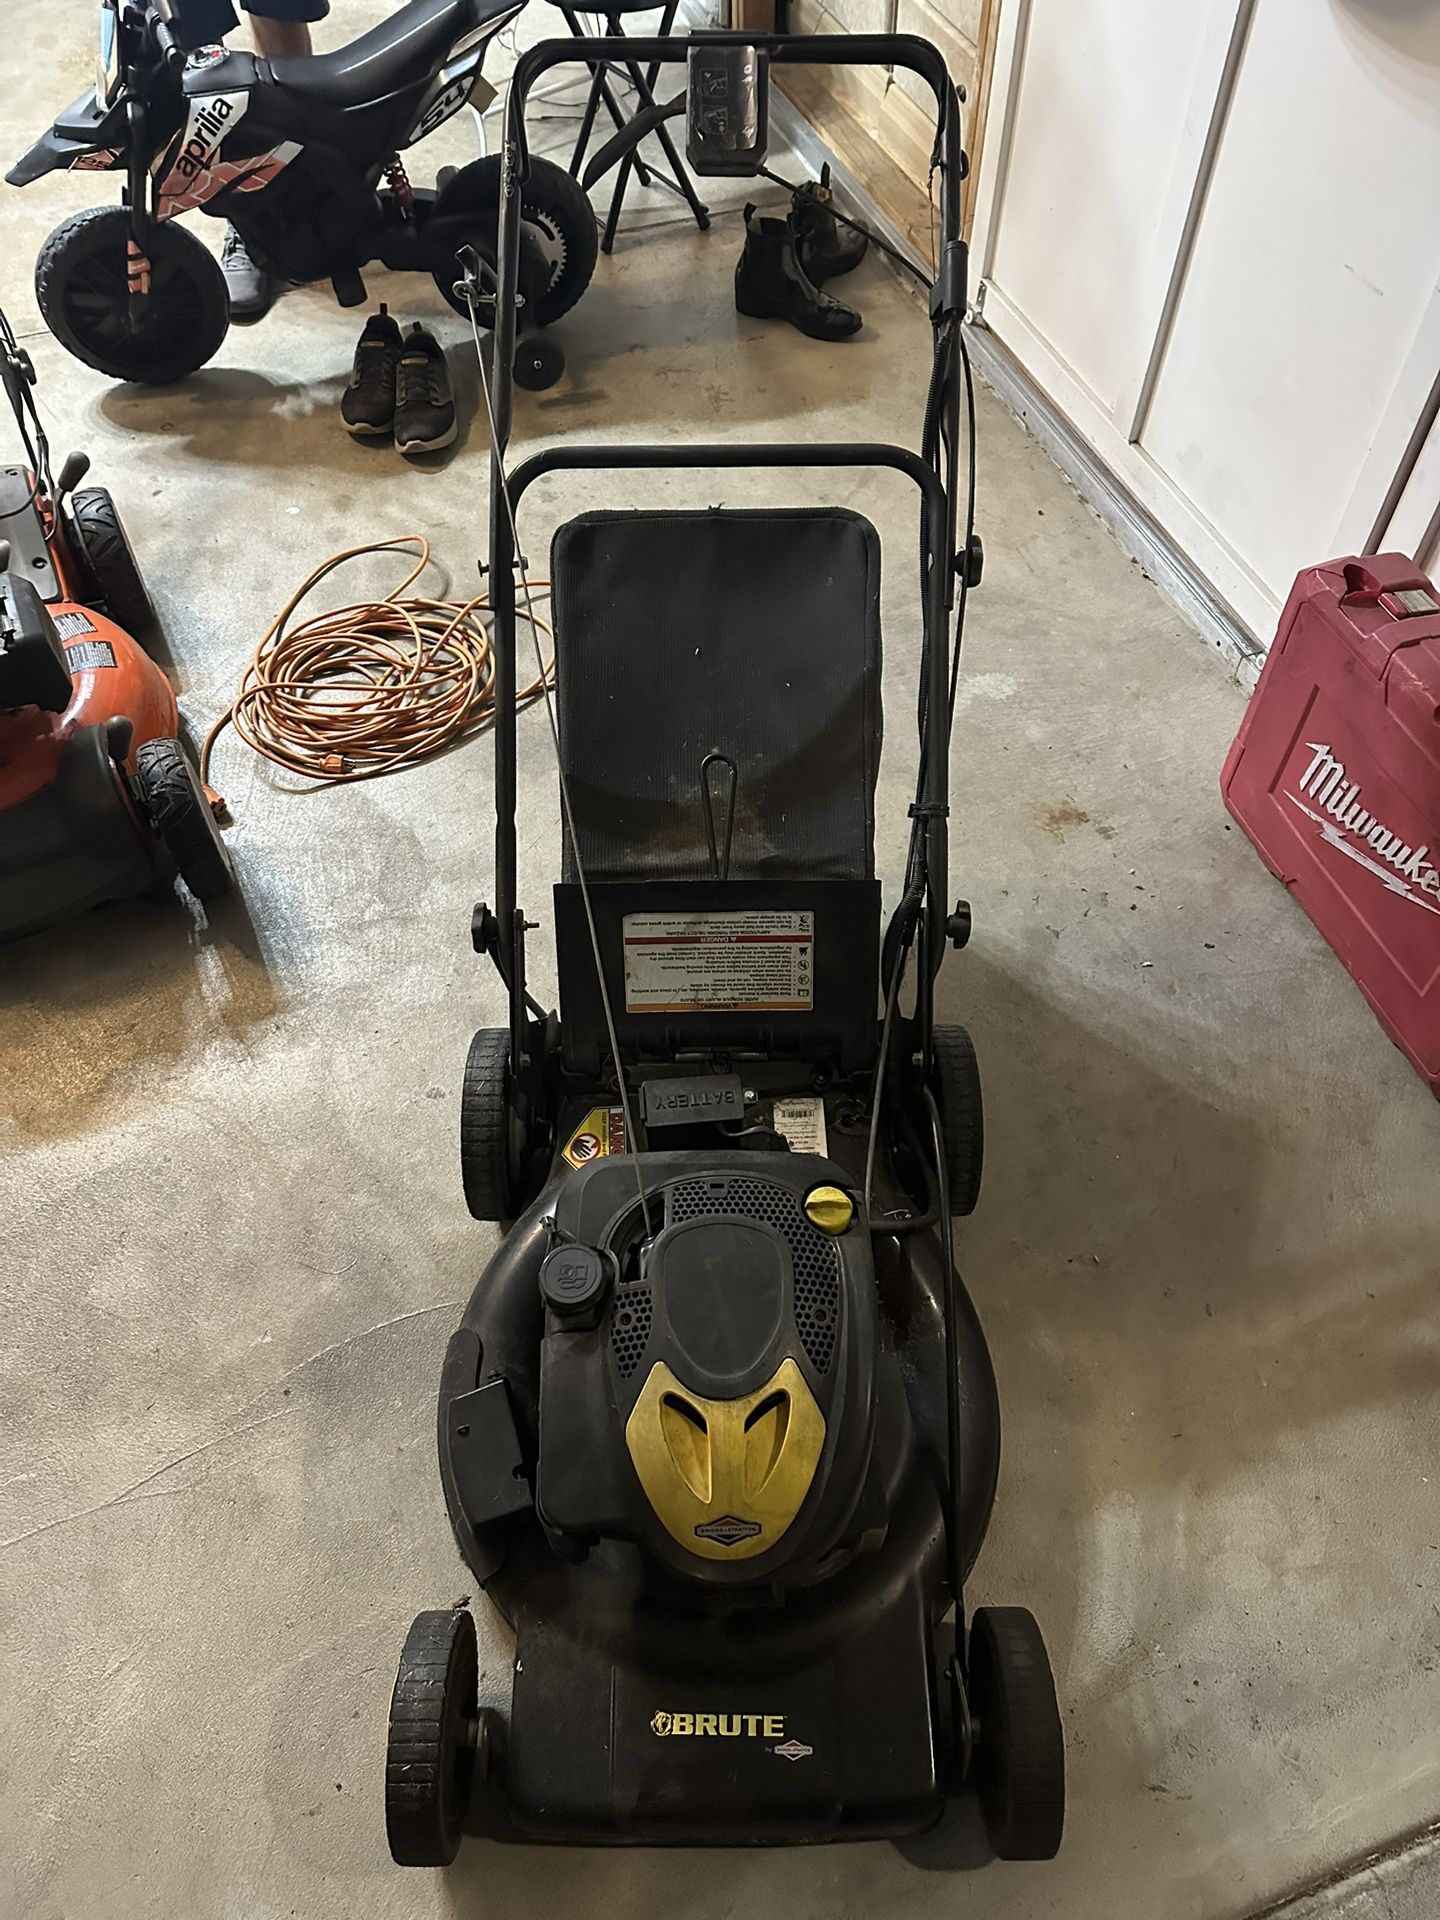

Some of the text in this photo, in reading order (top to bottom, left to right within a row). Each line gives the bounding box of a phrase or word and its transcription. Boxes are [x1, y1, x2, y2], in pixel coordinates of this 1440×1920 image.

[175, 96, 234, 177] aprilia
[1299, 742, 1440, 903] Milwauke
[656, 1091, 735, 1110] BATTERY
[672, 1714, 784, 1737] BRUTE
